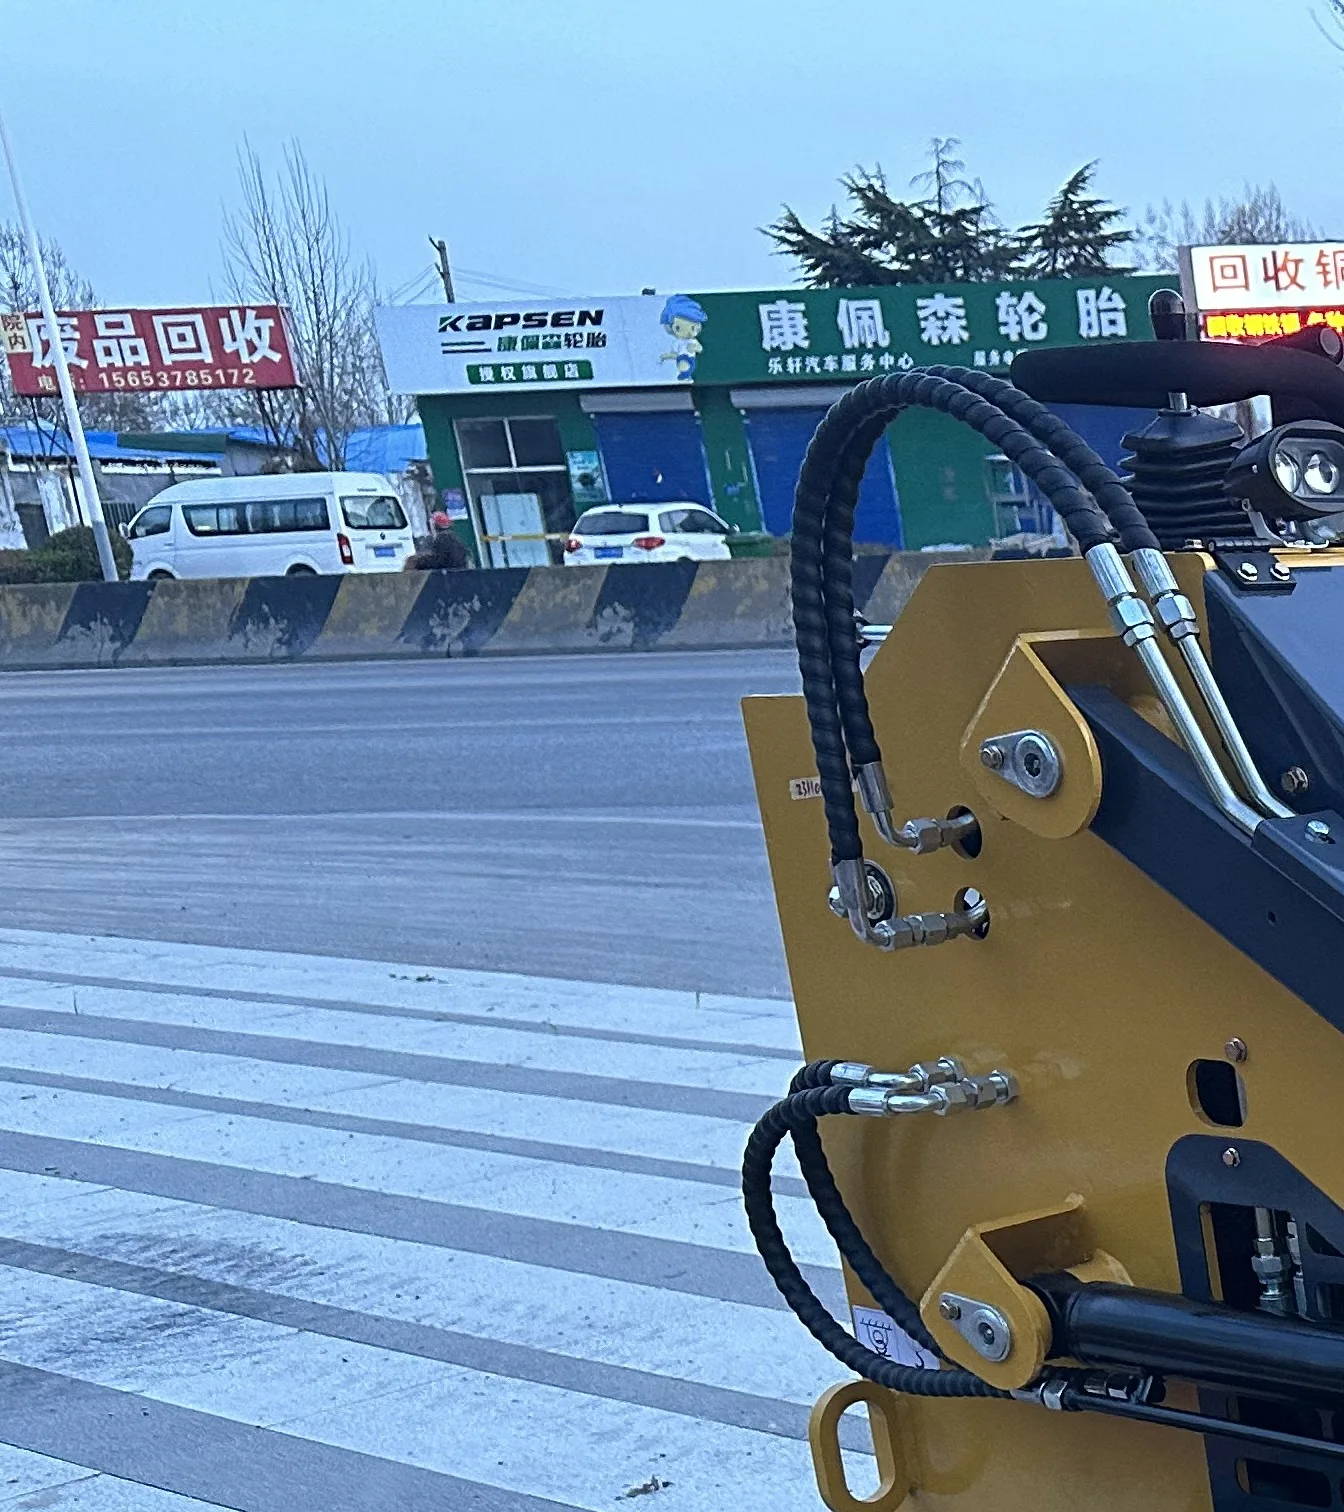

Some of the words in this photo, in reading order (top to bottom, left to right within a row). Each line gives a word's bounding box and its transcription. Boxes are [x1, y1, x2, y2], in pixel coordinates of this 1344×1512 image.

[1, 314, 27, 350] 院内
[26, 308, 282, 369] 废品回收
[757, 286, 1128, 351] 康佩森轮胎
[99, 367, 257, 389] 15653785172
